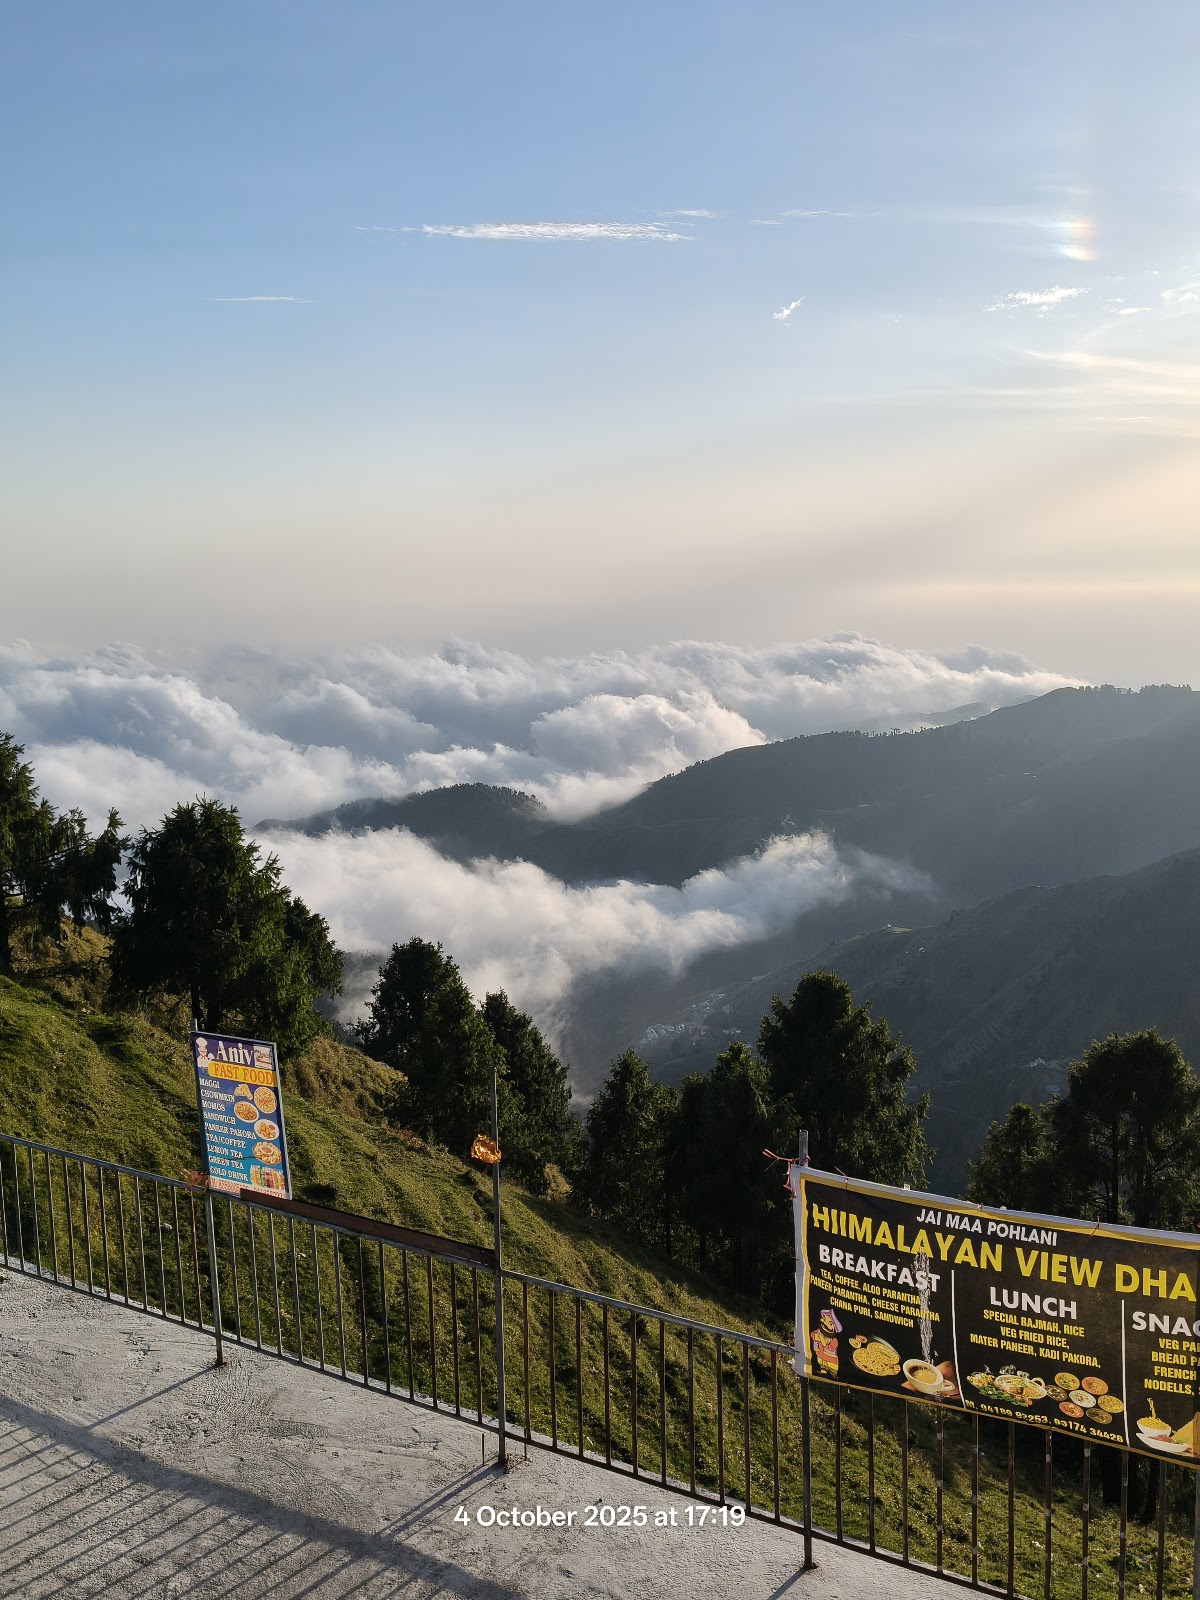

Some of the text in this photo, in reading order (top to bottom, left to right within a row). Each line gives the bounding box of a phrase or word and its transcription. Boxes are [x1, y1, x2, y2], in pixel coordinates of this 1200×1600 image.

[216, 1040, 254, 1065] Aniv
[199, 1078, 221, 1089] MAGGI
[213, 1063, 274, 1086] FAST FOOD
[201, 1089, 235, 1102] CHOWMEIN
[202, 1100, 226, 1112] MOMOS
[203, 1111, 236, 1125] SANDWICH
[206, 1133, 247, 1149] TEA/COFFEE
[230, 1127, 257, 1140] PAKORA
[207, 1143, 243, 1159] LEMON TEA
[208, 1155, 244, 1170] GREEN TEA
[210, 1166, 249, 1182] COLD DRINK
[917, 1208, 1058, 1247] JAI MAA POHLANI
[819, 1244, 941, 1293] BREAKFAST
[1015, 1246, 1103, 1288] VIEW
[1115, 1263, 1197, 1302] DHA
[820, 1268, 834, 1283] TEA,
[862, 1282, 881, 1296] ALOO
[810, 1274, 833, 1293] PANEER
[871, 1297, 900, 1313] CHEESE
[900, 1304, 941, 1323] PARANTHA
[989, 1286, 1077, 1320] LUNCH
[829, 1296, 914, 1329] CHANA PURI, SANDWICH
[983, 1309, 1085, 1338] SPECIAL RAJMAH, RICE
[1000, 1326, 1070, 1349] VEG FRIED RICE,
[1158, 1338, 1179, 1351] VEG
[970, 1333, 1101, 1369] MATER PANEER, KADI PAKORA,
[1151, 1351, 1187, 1366] BREAD
[1154, 1365, 1197, 1381] FRENCH
[1143, 1378, 1194, 1396] NODELLS,
